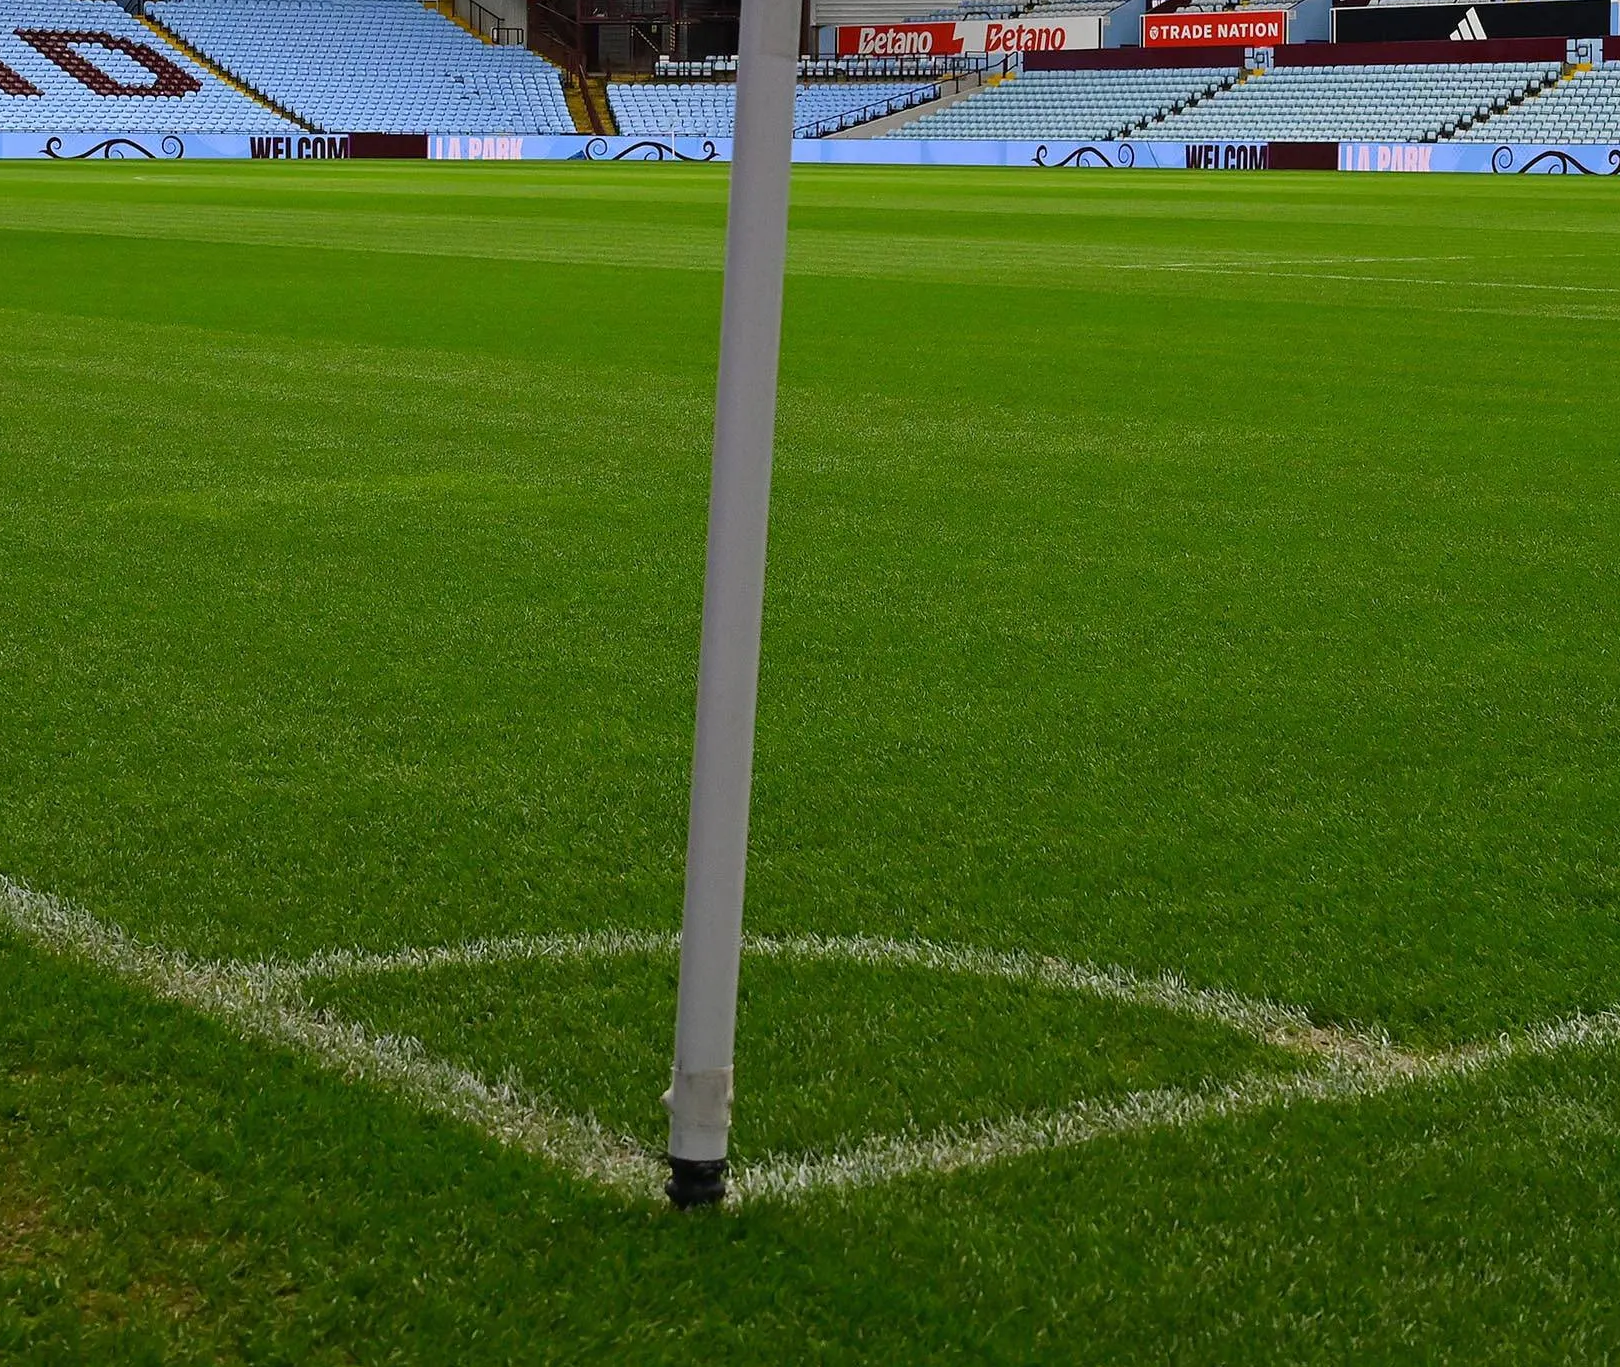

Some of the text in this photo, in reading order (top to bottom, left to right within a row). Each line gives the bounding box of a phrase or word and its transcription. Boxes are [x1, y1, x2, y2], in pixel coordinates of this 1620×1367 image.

[858, 27, 933, 55] Betano
[985, 23, 1066, 52] Betano
[1161, 23, 1279, 39] TRADE NATION
[250, 136, 348, 159] WELCOM
[469, 137, 524, 160] PARK
[1186, 145, 1268, 169] WELCOM
[1380, 146, 1431, 171] PARK
